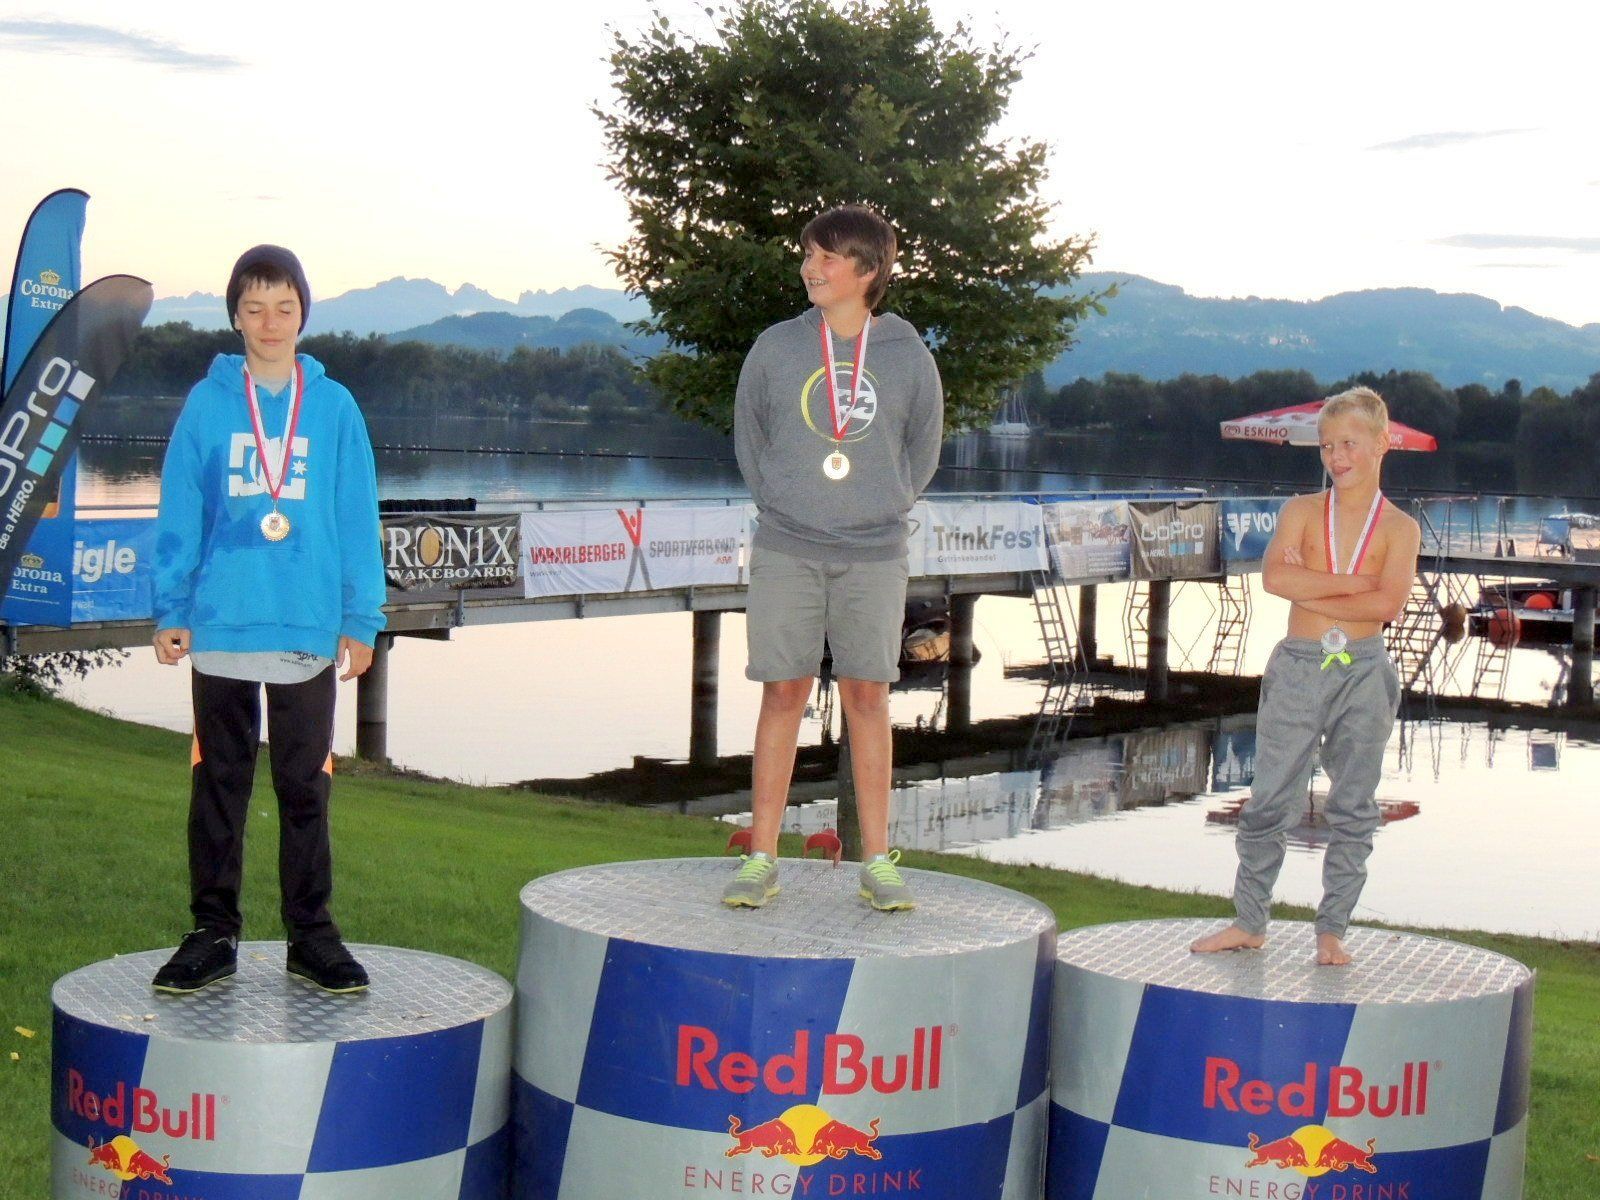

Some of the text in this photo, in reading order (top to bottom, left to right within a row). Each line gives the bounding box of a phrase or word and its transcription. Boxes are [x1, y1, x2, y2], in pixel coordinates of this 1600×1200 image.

[22, 279, 74, 300] Corona
[31, 297, 64, 311] Extra
[1244, 426, 1288, 438] ESKIMO
[5, 524, 15, 533] a
[933, 524, 1042, 551] TrinkFest
[1141, 521, 1204, 542] GoPro
[530, 543, 626, 564] VORARLBERGER
[649, 537, 736, 558] SPORTVERBAND
[386, 566, 514, 580] WAKEBOARDS
[12, 579, 48, 594] Extra
[676, 1024, 942, 1096] Red Bull
[1203, 1057, 1429, 1118] Red Bull
[67, 1068, 215, 1141] Red Bull
[73, 1168, 130, 1200] ENERGY
[684, 1166, 922, 1196] ENERGY DRINK
[1209, 1175, 1411, 1200] ENERGY DRINK
